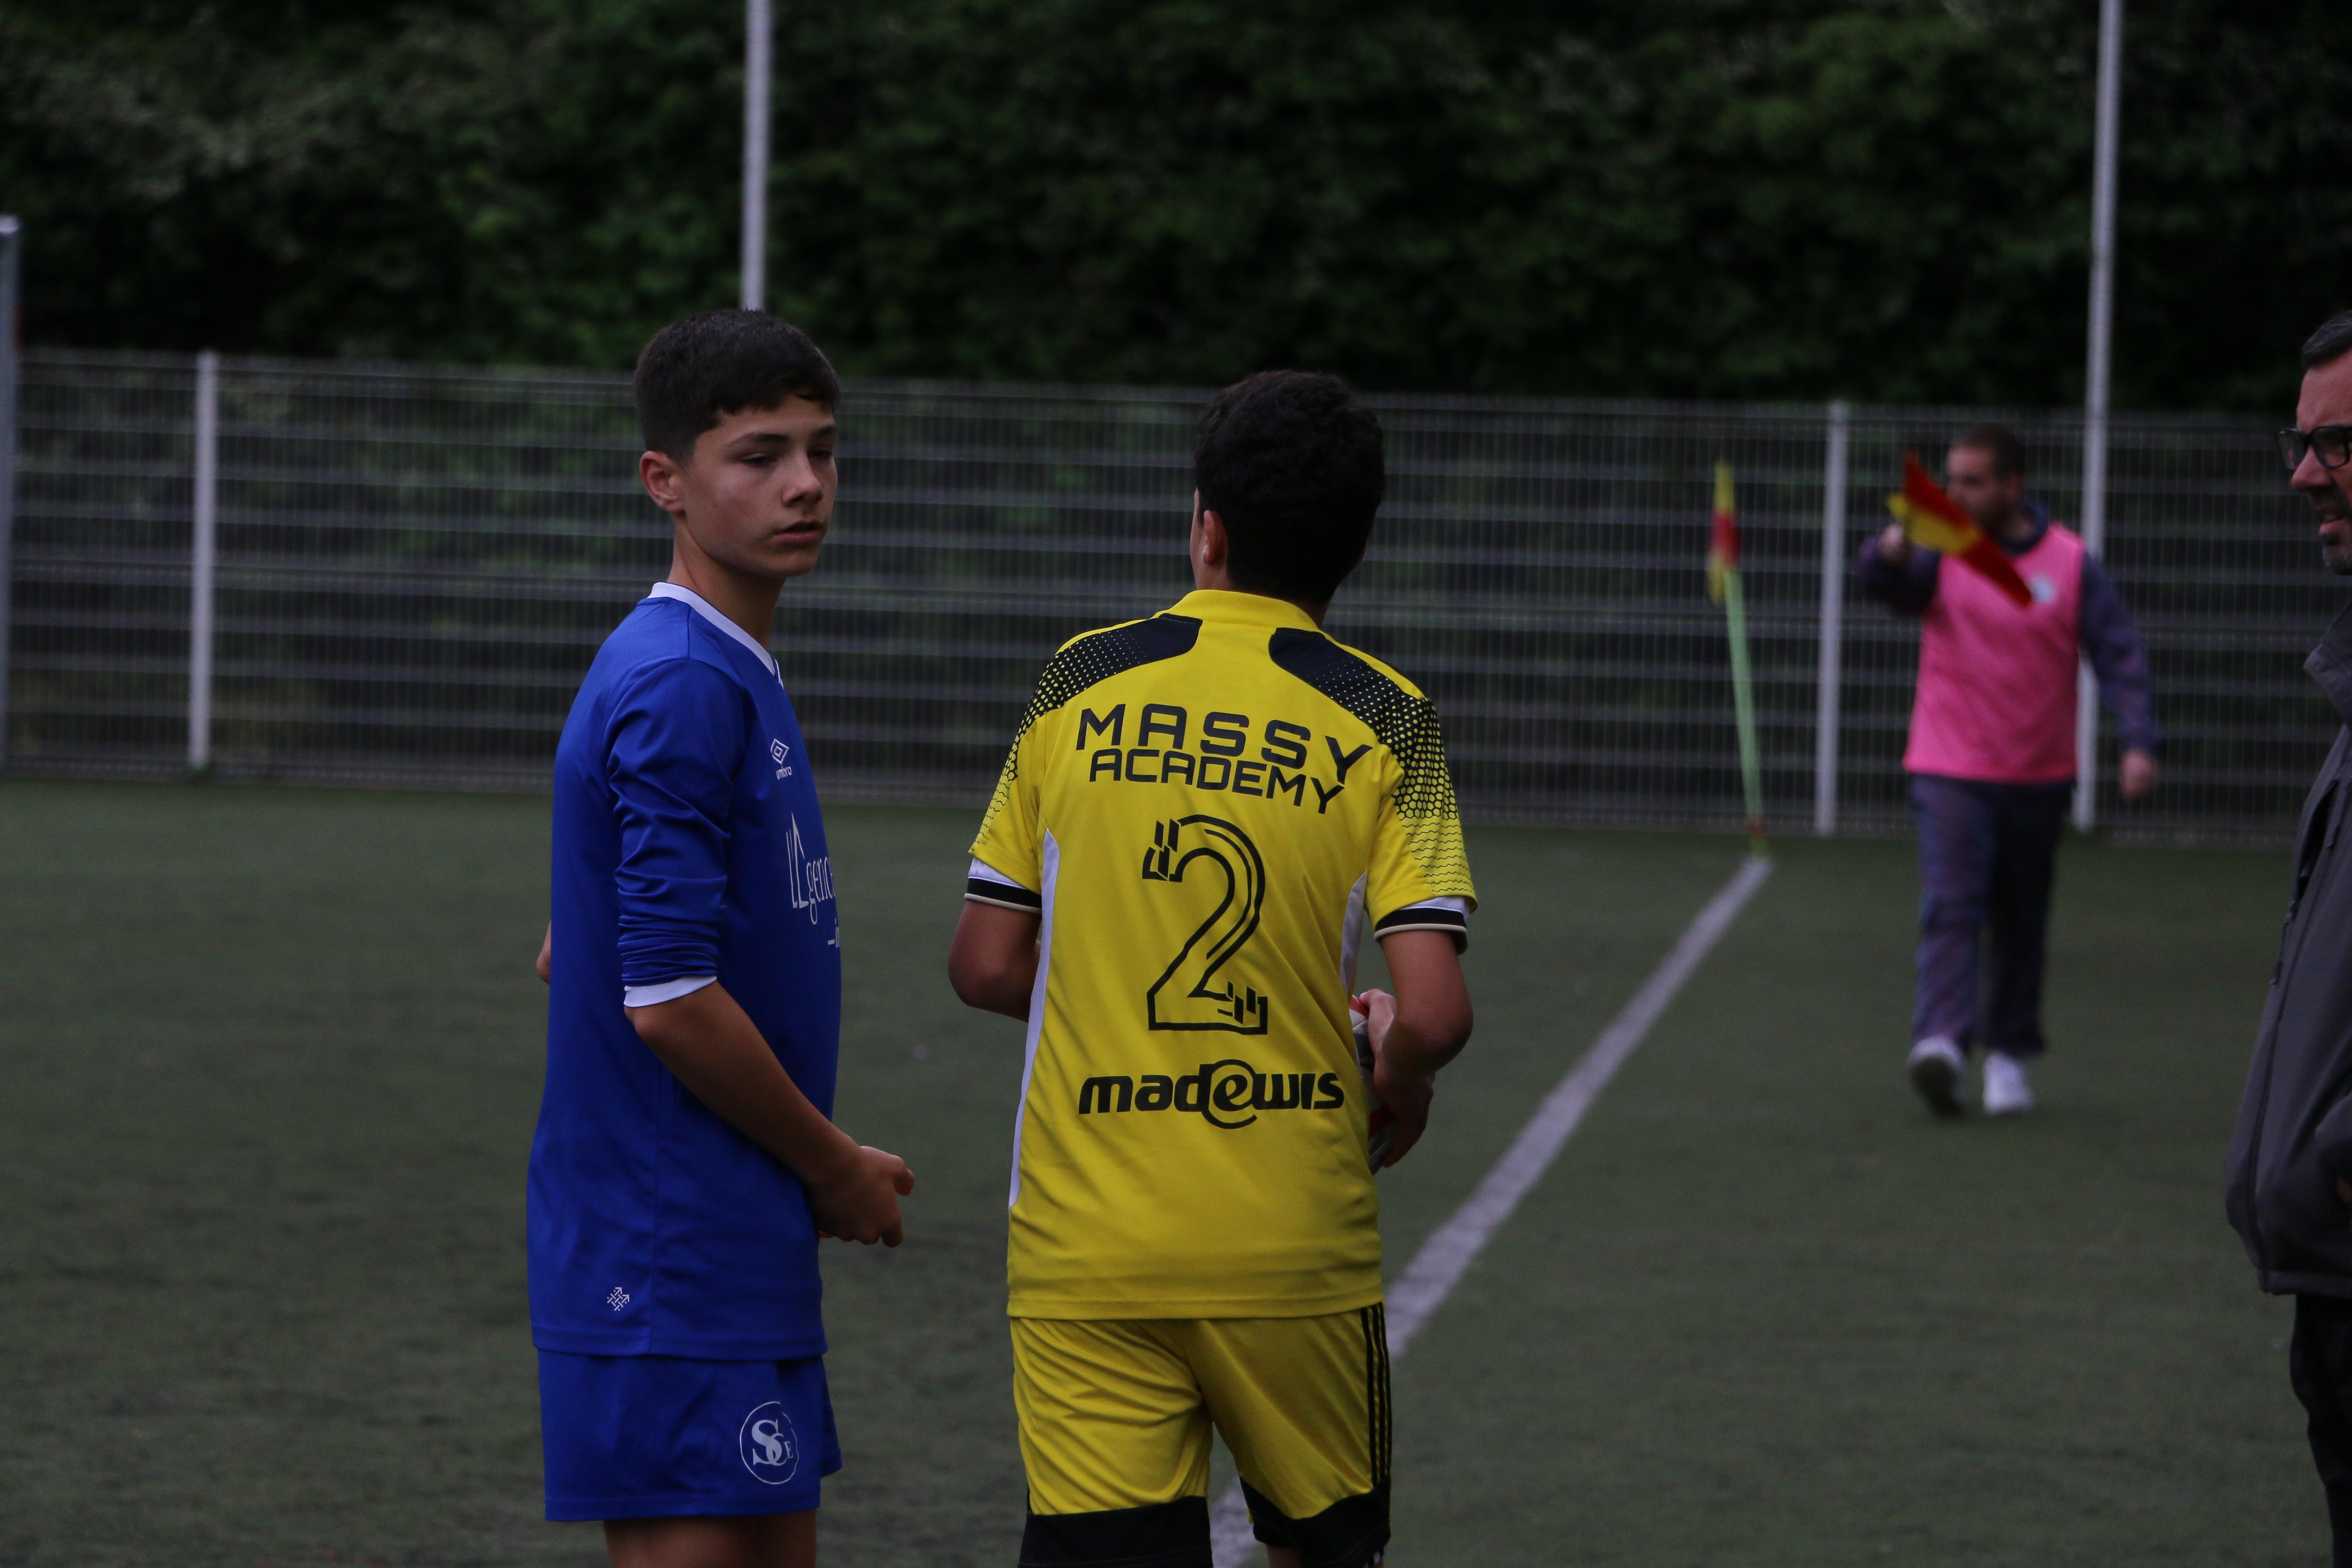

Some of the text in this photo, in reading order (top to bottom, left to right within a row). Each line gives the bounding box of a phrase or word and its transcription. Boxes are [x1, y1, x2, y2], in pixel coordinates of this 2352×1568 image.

[1076, 703, 1373, 787] MASSY
[1089, 749, 1345, 815] ACADEMY
[1142, 814, 1268, 1035] 2
